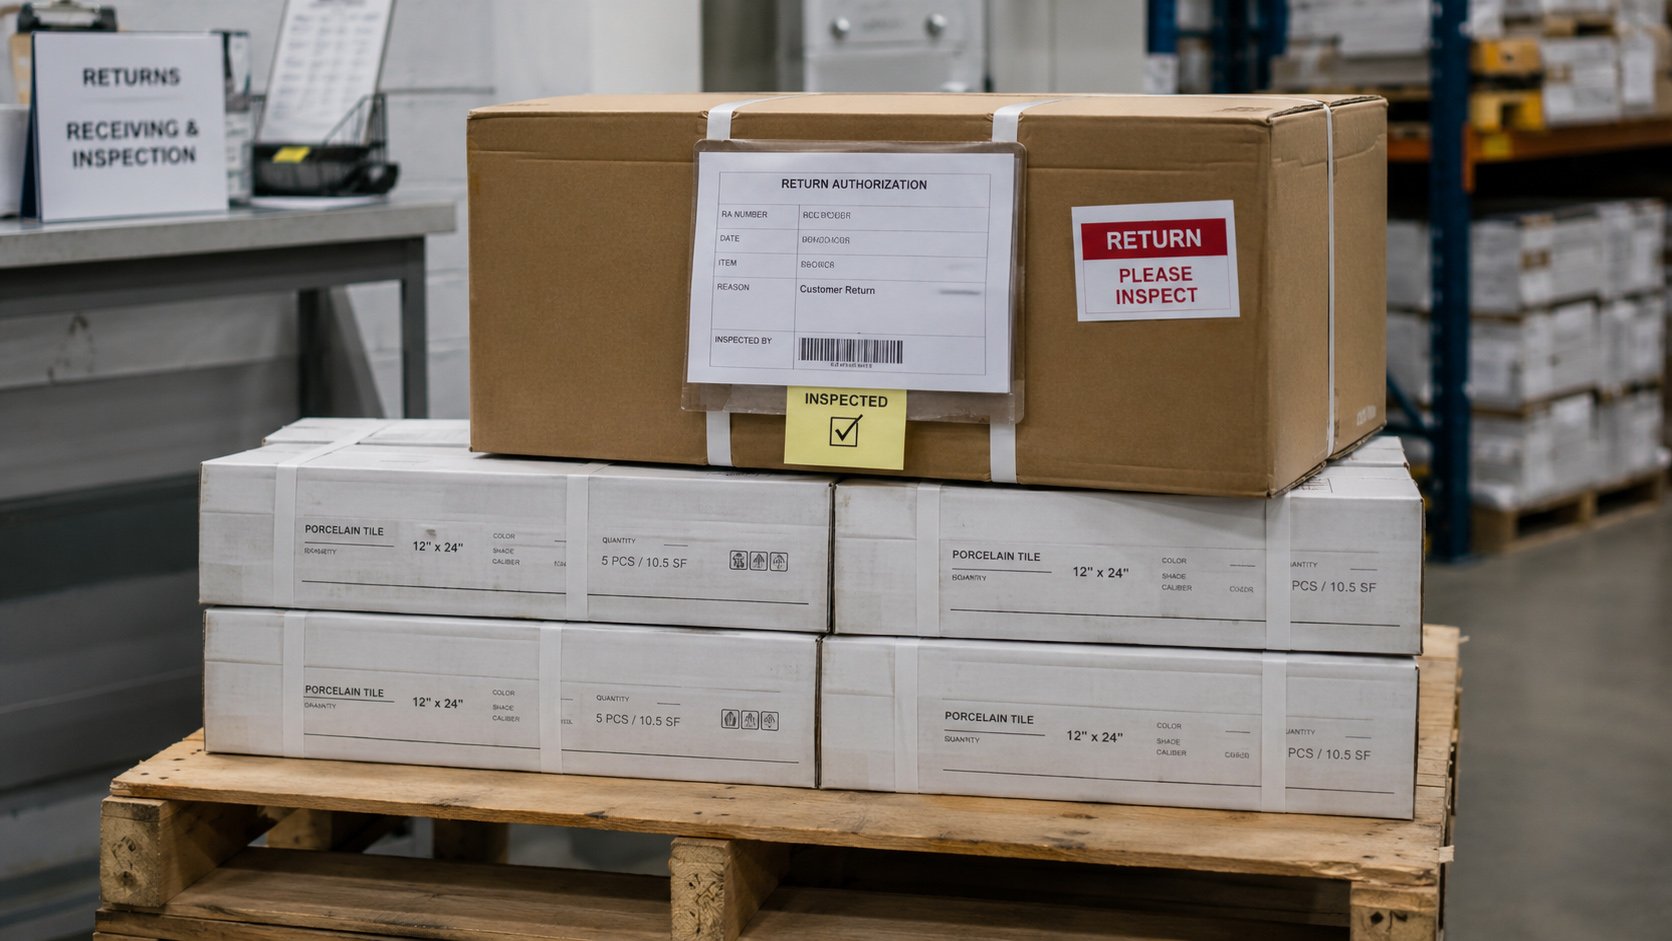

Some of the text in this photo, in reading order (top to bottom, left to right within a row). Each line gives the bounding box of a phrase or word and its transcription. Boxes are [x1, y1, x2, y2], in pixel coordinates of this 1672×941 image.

[83, 68, 180, 86] RETURNS
[67, 120, 199, 140] RECEIVING &
[73, 147, 195, 167] INSPECTION
[782, 179, 927, 189] RETURN AUTHORIZATION
[733, 211, 768, 219] NUMBER
[719, 235, 740, 243] DATE
[1107, 229, 1201, 250] RETURN
[718, 259, 738, 267] ITEM
[1120, 266, 1192, 283] PLEASE
[716, 283, 750, 292] REASON
[799, 285, 876, 295] Customer Return
[1116, 288, 1198, 304] INSPECT
[714, 336, 773, 345] INSPECTED BY
[806, 393, 887, 407] INSPECTED
[305, 525, 383, 536] PORCELAIN TILE
[413, 541, 463, 552] 12" x 24"
[601, 537, 636, 545] QUANTITY
[953, 550, 1040, 561] PORCELAIN TILE
[601, 556, 687, 568] 5 PCS / 10.5 SF
[1074, 567, 1128, 578] 12" x 24"
[1292, 580, 1376, 592] PCS / 10.5 SF
[306, 685, 384, 697] PORCELAIN TILE
[491, 689, 516, 697] COLOR
[413, 697, 463, 709] 12" x 24"
[595, 713, 680, 726] 5 PCS / 10.5 SF
[945, 711, 1033, 724] PORCELAIN TILE
[1156, 722, 1183, 730] COLOR
[1068, 730, 1123, 743] 12" x 24"
[1289, 747, 1371, 760] PCS / 10.5 SF
